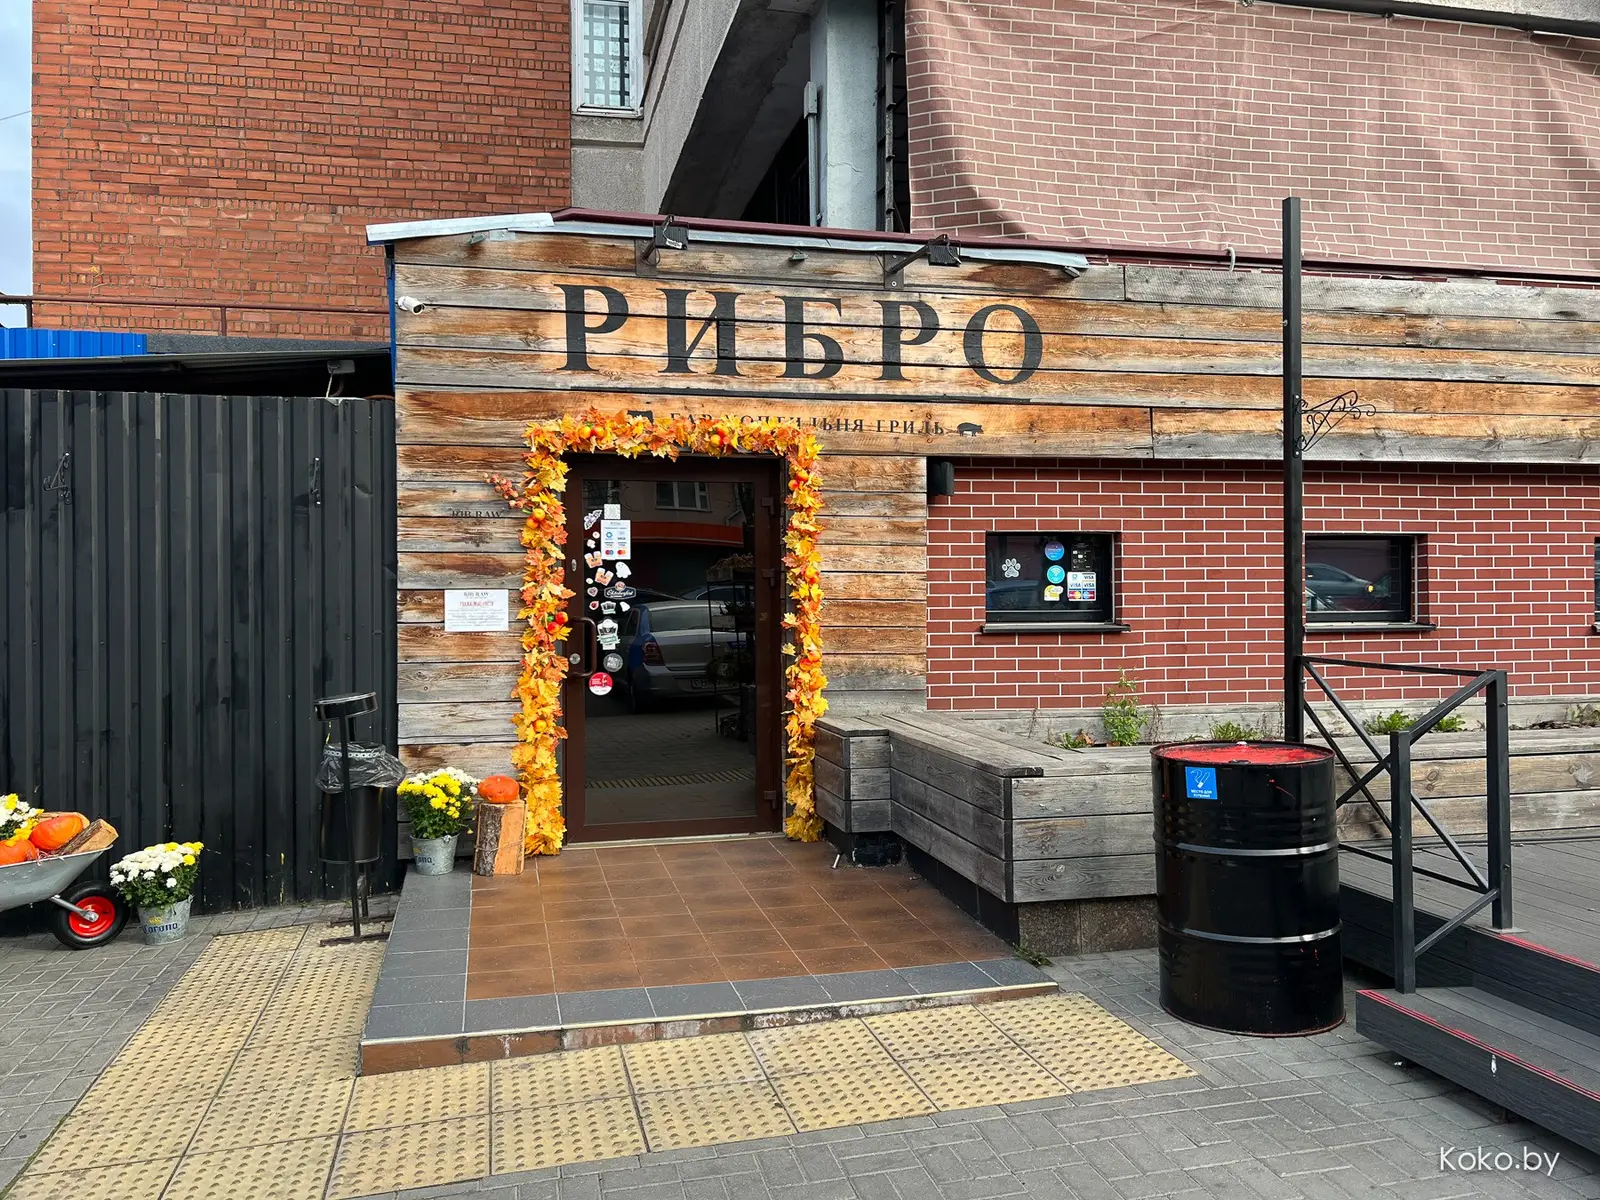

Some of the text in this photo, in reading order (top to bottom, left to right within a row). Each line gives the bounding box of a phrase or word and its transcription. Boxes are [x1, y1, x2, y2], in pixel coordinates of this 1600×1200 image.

[553, 283, 1044, 385] РИБРО
[876, 419, 944, 435] ГРИЛЬ
[143, 922, 178, 934] Corona
